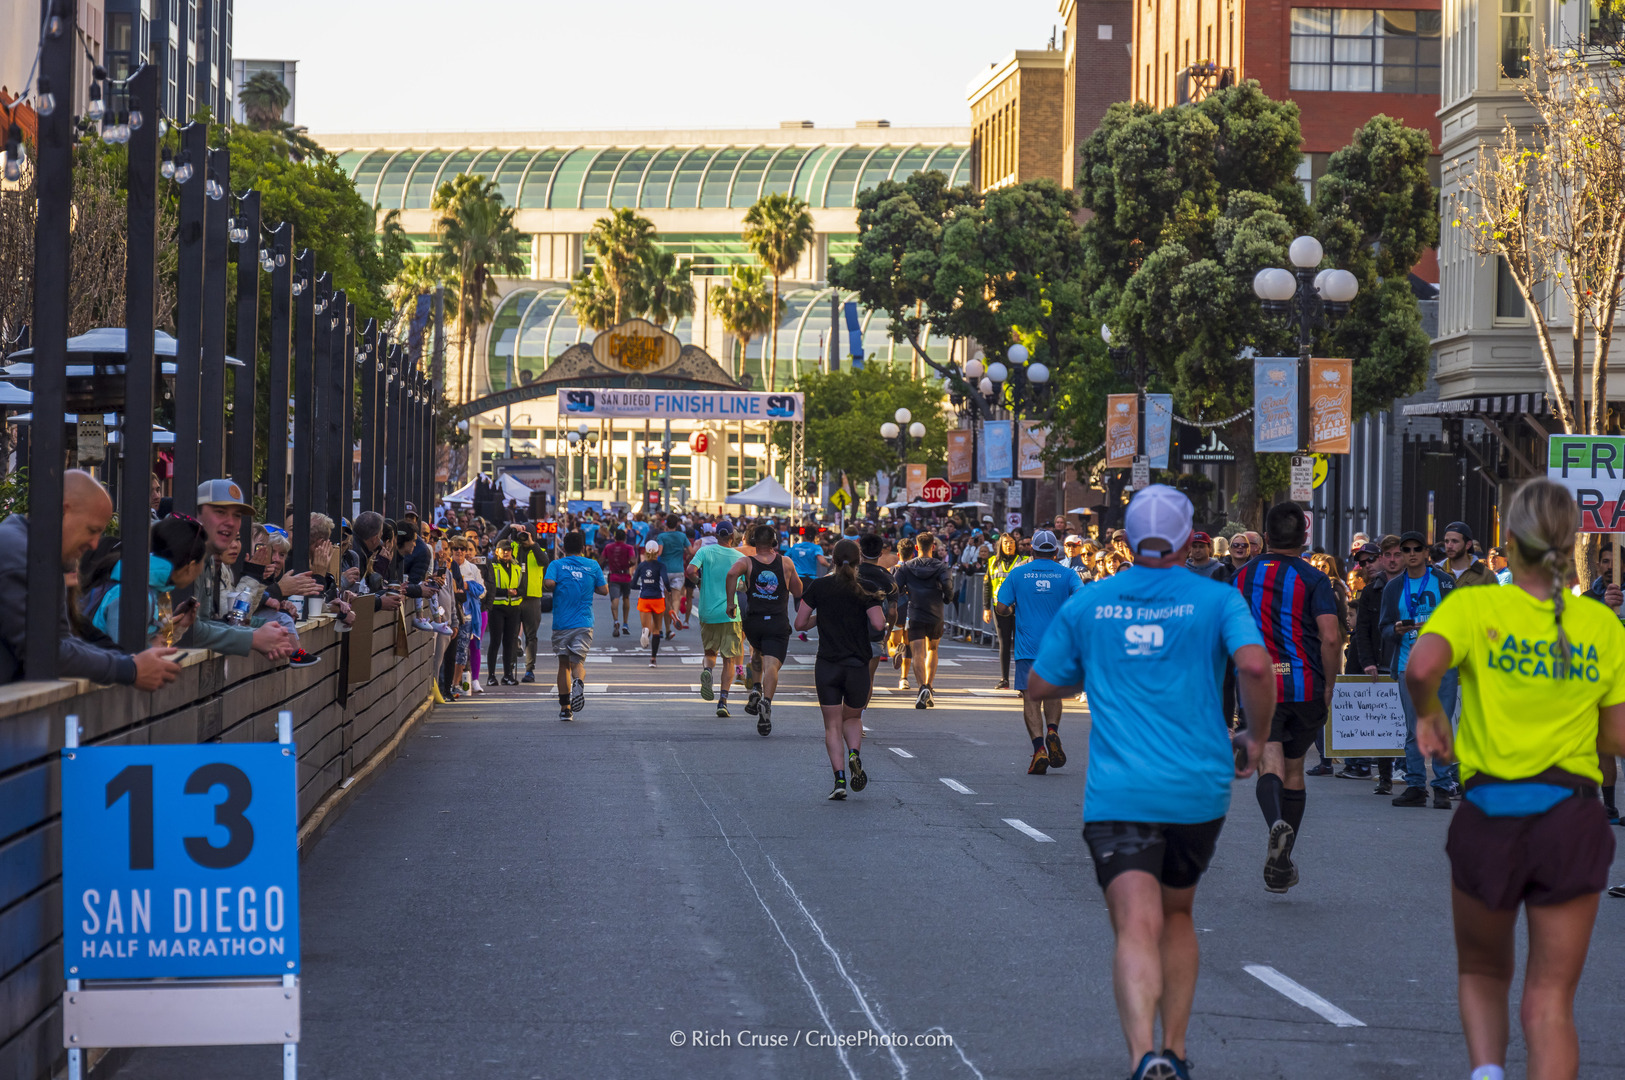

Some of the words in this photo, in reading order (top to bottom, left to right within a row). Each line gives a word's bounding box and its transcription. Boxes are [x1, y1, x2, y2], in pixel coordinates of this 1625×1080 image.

[601, 393, 618, 405] SAN
[623, 394, 650, 406] DIEGO
[655, 395, 714, 413] FINISH
[719, 397, 760, 414] LINE
[1315, 392, 1347, 411] Good
[1261, 417, 1293, 430] START
[1315, 418, 1346, 431] START
[1260, 424, 1294, 440] HERE
[1314, 425, 1347, 442] HERE
[698, 436, 705, 449] F
[1562, 443, 1625, 479] FR
[924, 487, 950, 499] STOP
[1095, 604, 1133, 620] 2023
[1136, 604, 1195, 620] FINISHER
[1501, 634, 1599, 663] ASCONA
[1353, 687, 1371, 698] can't
[1376, 688, 1398, 700] really
[1334, 700, 1354, 710] with
[1360, 729, 1375, 737] Well
[105, 762, 255, 870] 13
[82, 889, 151, 935] SAN
[173, 886, 284, 934] DIEGO
[82, 939, 138, 958] HALF
[149, 937, 284, 957] MARATHON
